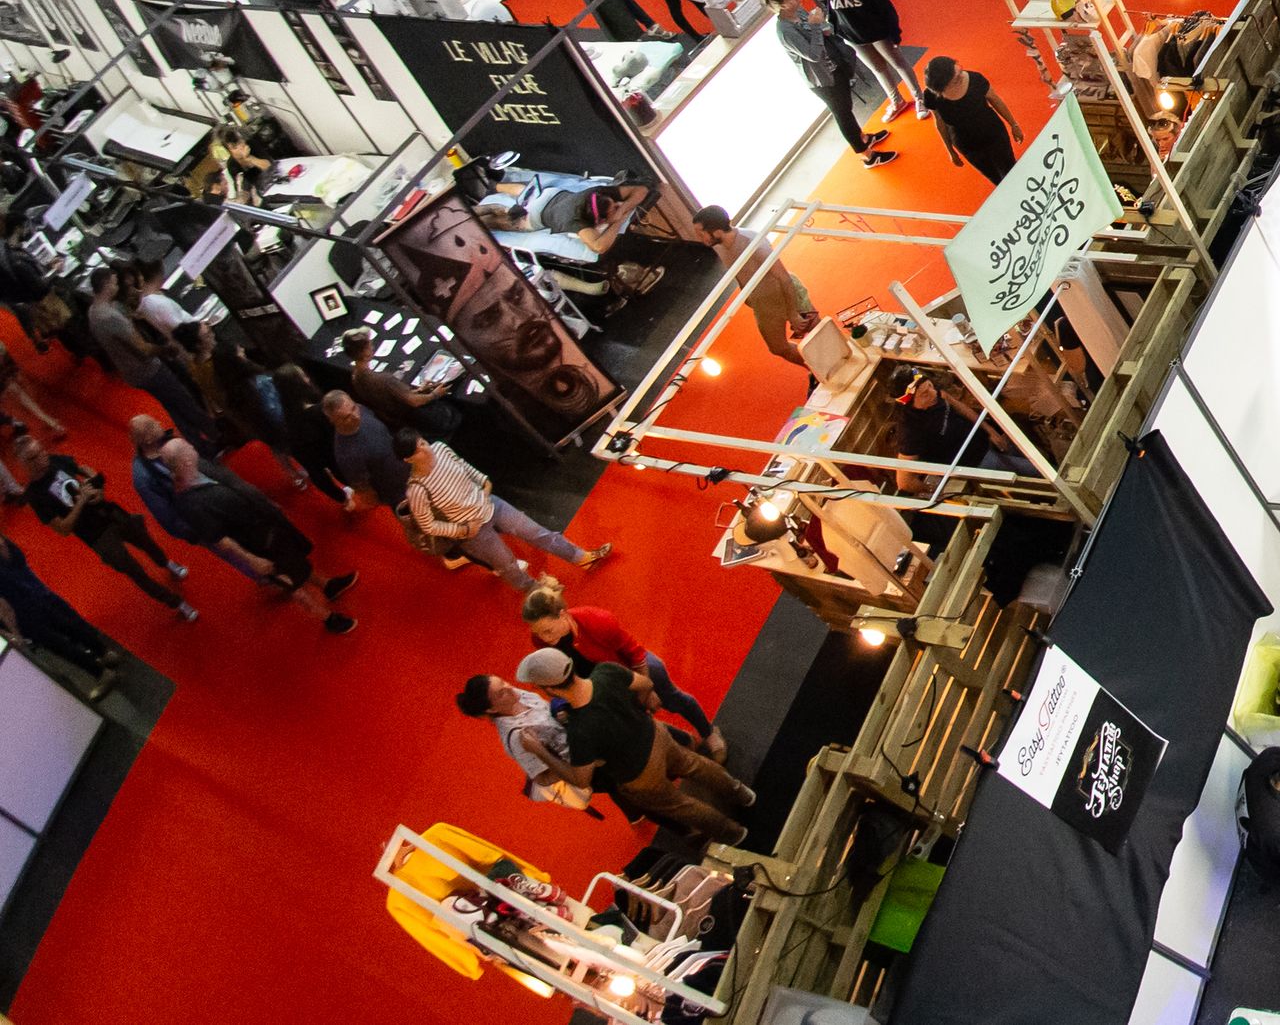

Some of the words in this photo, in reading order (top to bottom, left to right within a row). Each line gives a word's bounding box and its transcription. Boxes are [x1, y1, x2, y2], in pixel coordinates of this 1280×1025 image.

[441, 39, 474, 63] LE
[1017, 727, 1045, 777] Easy
[1038, 674, 1067, 732] Tattoo
